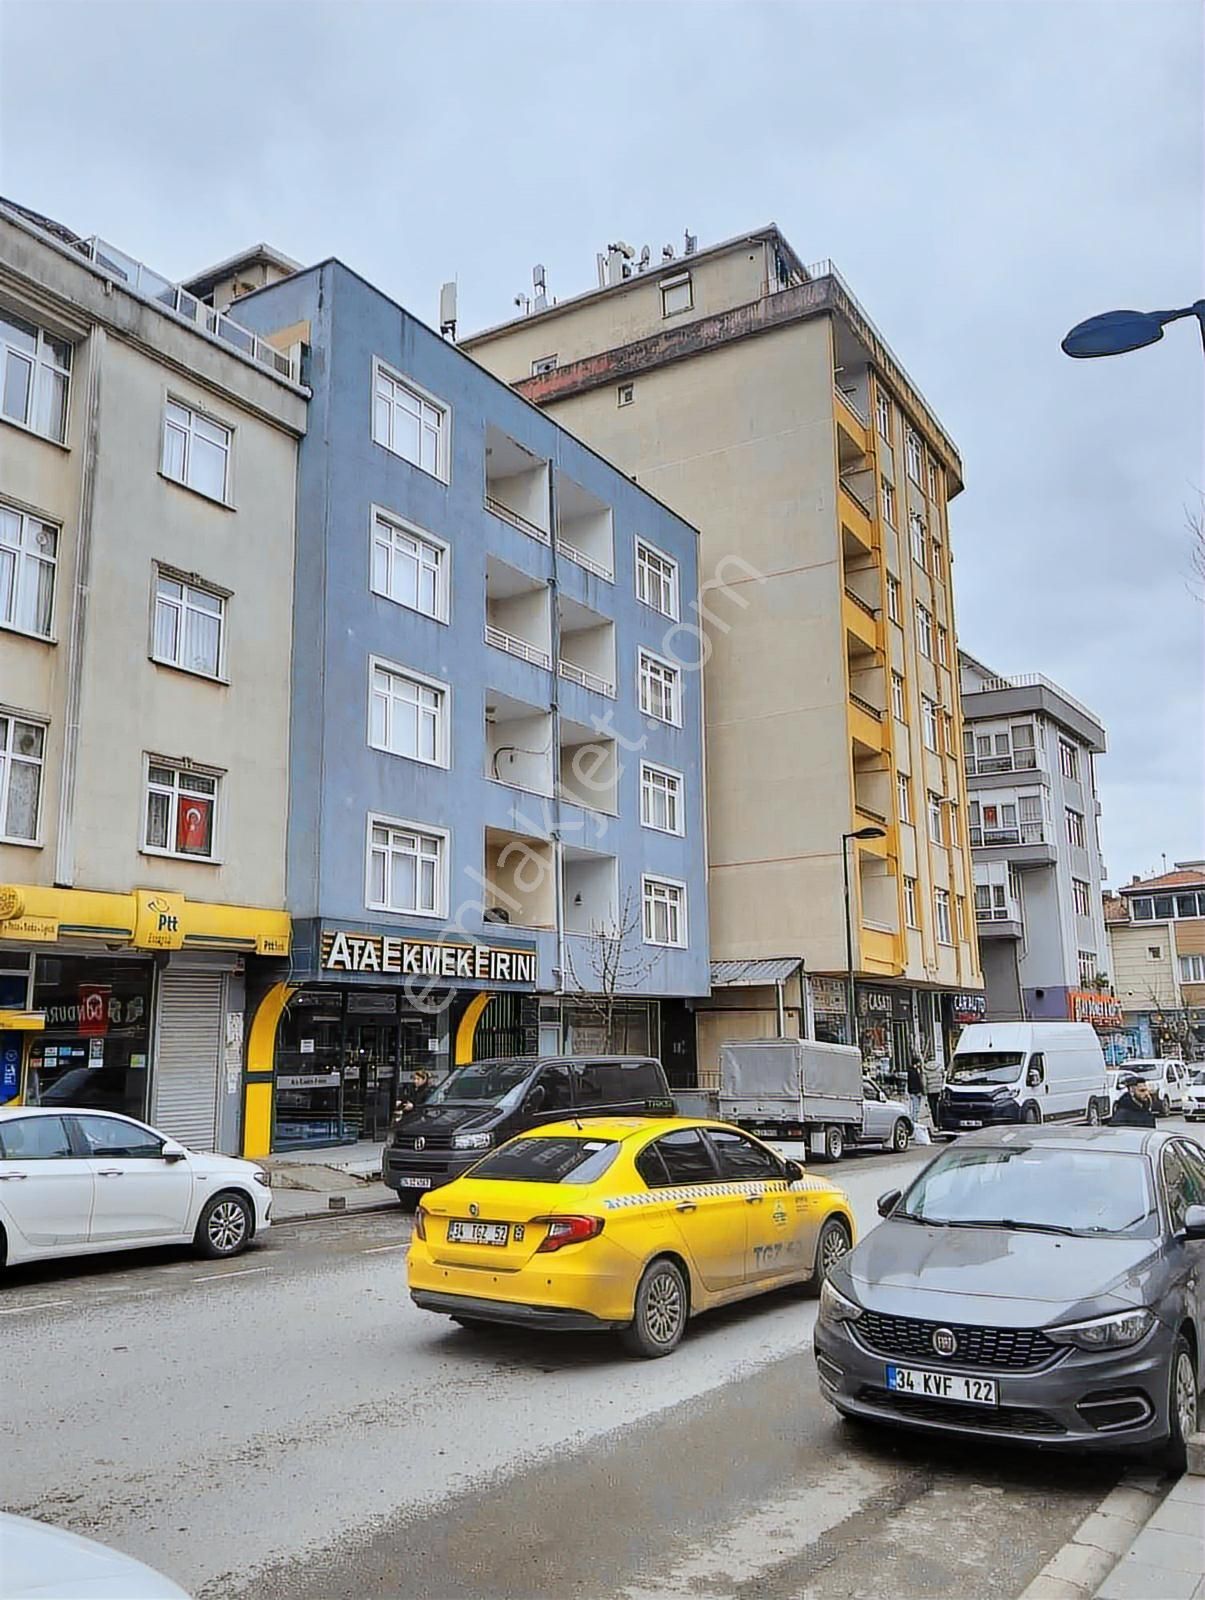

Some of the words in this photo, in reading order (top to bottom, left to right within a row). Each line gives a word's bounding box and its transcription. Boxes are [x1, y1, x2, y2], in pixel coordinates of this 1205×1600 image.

[158, 913, 179, 932] Ptt
[327, 932, 379, 972] ATA
[383, 936, 473, 977] EKMEK
[475, 945, 535, 981] FIRINI
[896, 1369, 914, 1391] 34
[923, 1373, 953, 1396] KVF
[964, 1379, 994, 1402] 122
